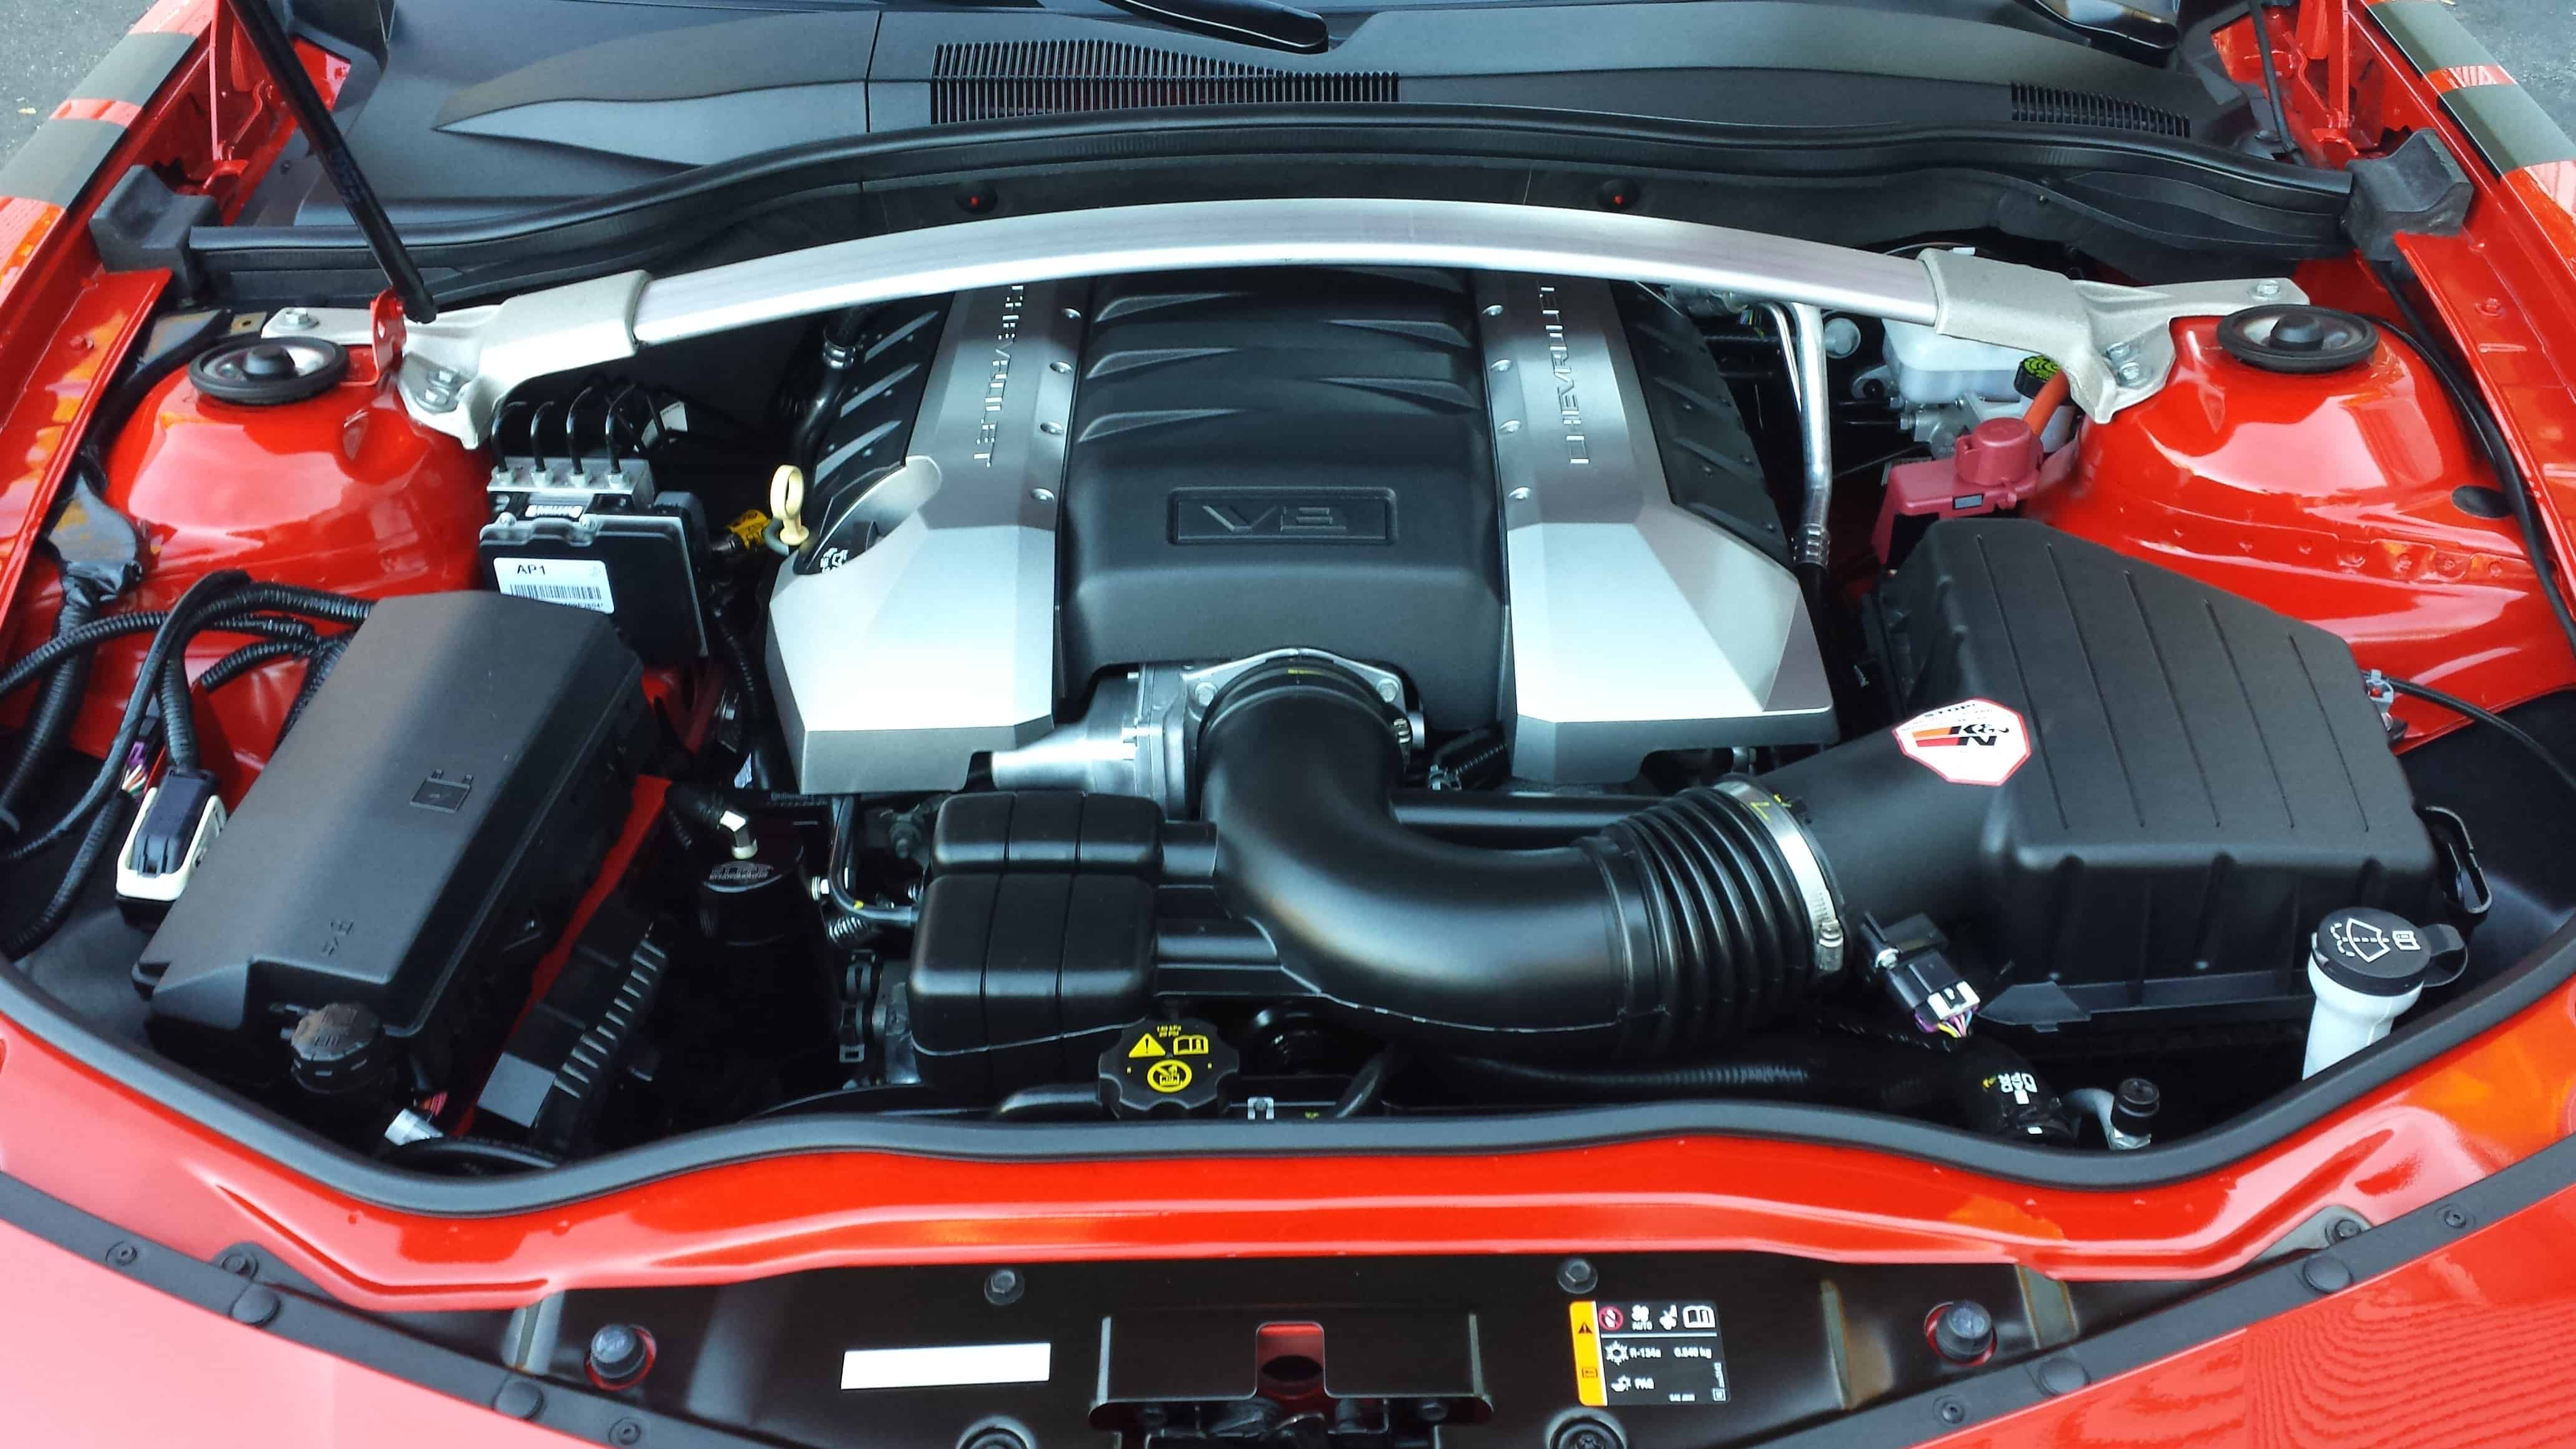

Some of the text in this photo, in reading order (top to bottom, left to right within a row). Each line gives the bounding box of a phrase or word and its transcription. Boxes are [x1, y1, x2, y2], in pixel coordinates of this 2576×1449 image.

[973, 285, 1025, 468] CHEVROLET
[1537, 280, 1590, 465] CHEVROLET
[1202, 505, 1348, 533] V8
[517, 564, 546, 575] AP1
[1629, 1347, 1662, 1358] R-134a
[1699, 1347, 1712, 1359] kg
[1634, 1377, 1654, 1389] PAG
